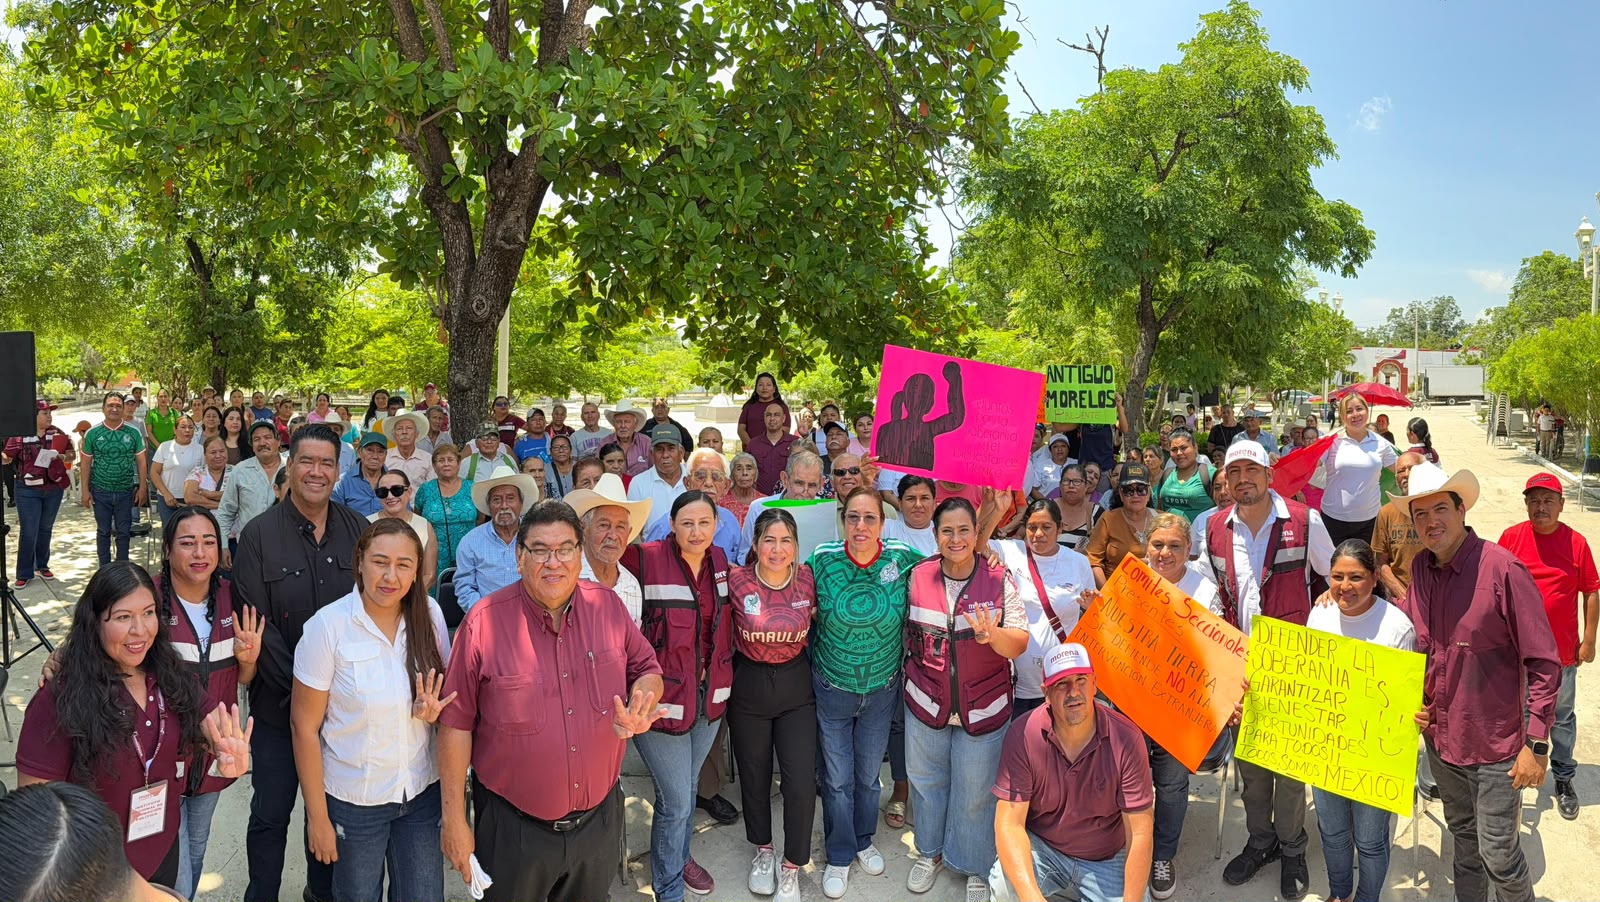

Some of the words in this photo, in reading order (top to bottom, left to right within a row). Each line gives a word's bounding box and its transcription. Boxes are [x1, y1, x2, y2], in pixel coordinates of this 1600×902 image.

[1046, 364, 1113, 384] ANTIGUO
[1046, 389, 1117, 409] MORELOS
[1228, 449, 1257, 459] morena
[1164, 496, 1188, 504] SPORT
[1113, 574, 1184, 637] Presentes
[852, 631, 875, 642] XIX
[1100, 597, 1159, 652] NUESTRA
[1166, 645, 1217, 694] TIERRA
[1174, 597, 1250, 662] Seccionales
[1050, 650, 1080, 664] morena
[1256, 619, 1338, 665] DEFENDER
[1352, 645, 1375, 677] LA
[1166, 670, 1186, 694] NO
[1249, 669, 1347, 713] GARANTIZAR
[1252, 644, 1350, 690] SOBERANIA
[1365, 677, 1390, 709] ES
[1244, 709, 1368, 759] OPORTUNIDADES
[1246, 692, 1347, 732] BIENESTAR
[1360, 720, 1370, 741] Y
[1243, 724, 1278, 751] PARA
